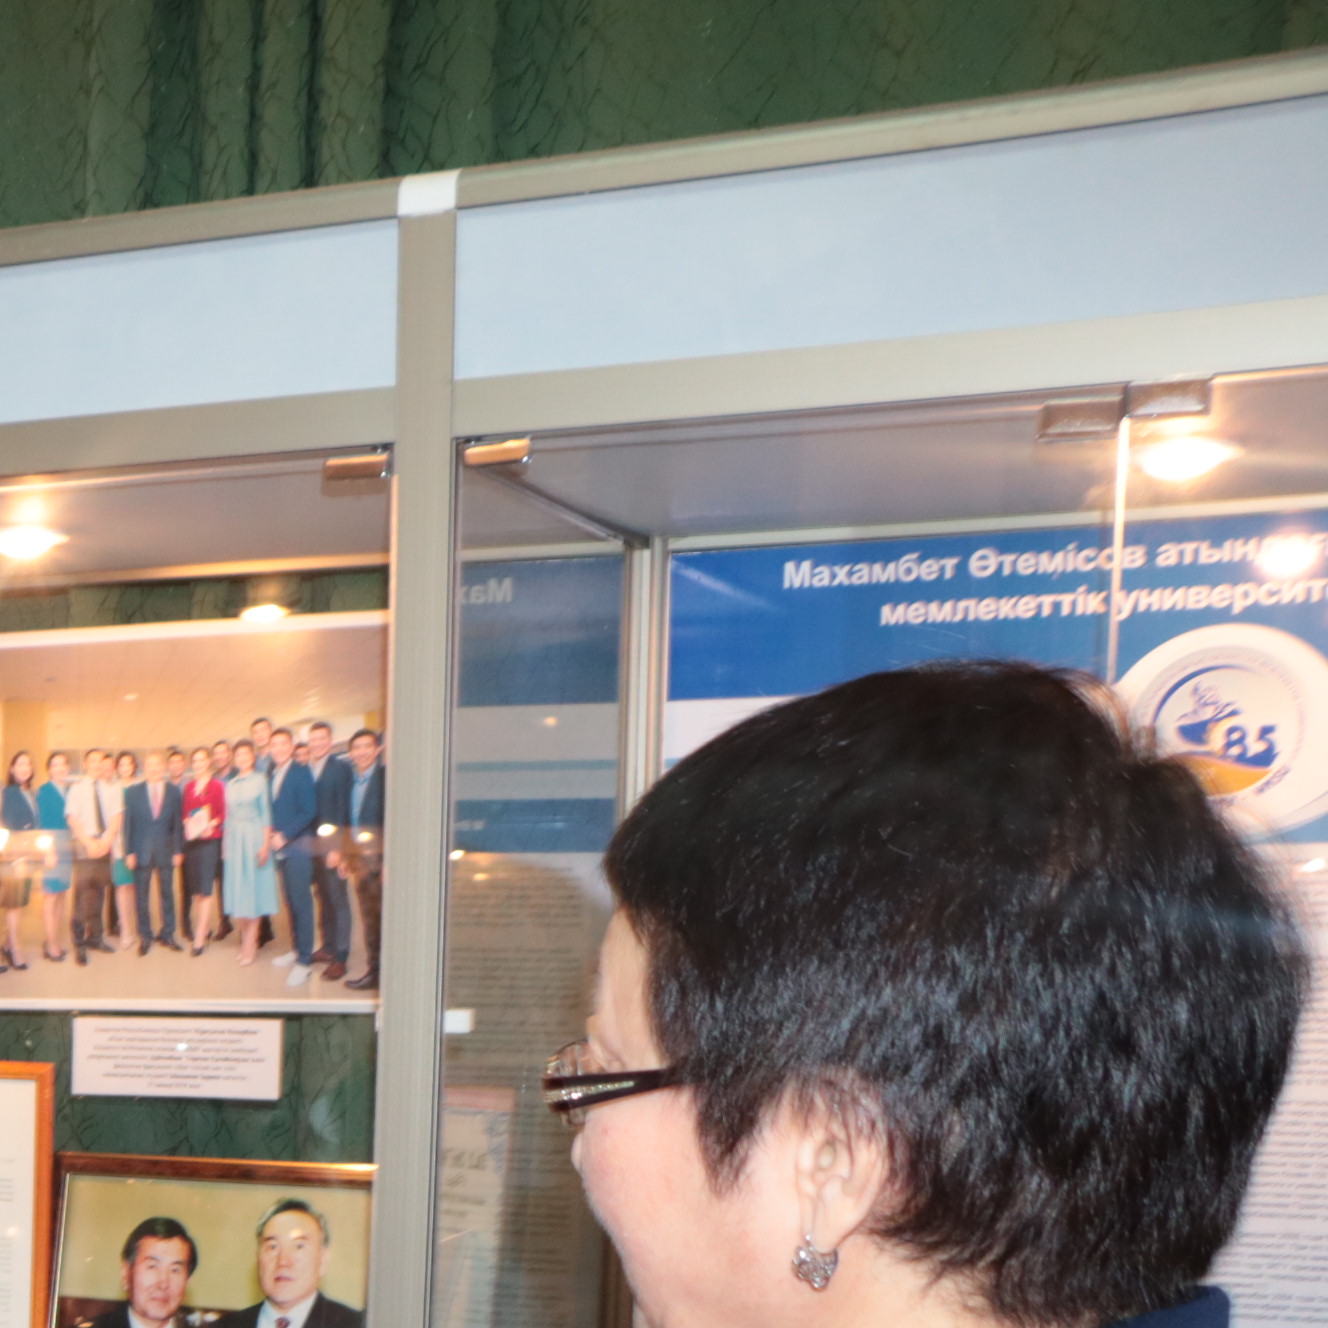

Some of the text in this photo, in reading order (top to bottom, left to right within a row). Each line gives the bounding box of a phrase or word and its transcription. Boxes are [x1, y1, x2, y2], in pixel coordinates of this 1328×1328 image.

[782, 555, 961, 590] Махамбет
[880, 577, 1328, 627] мемлекеттік университ
